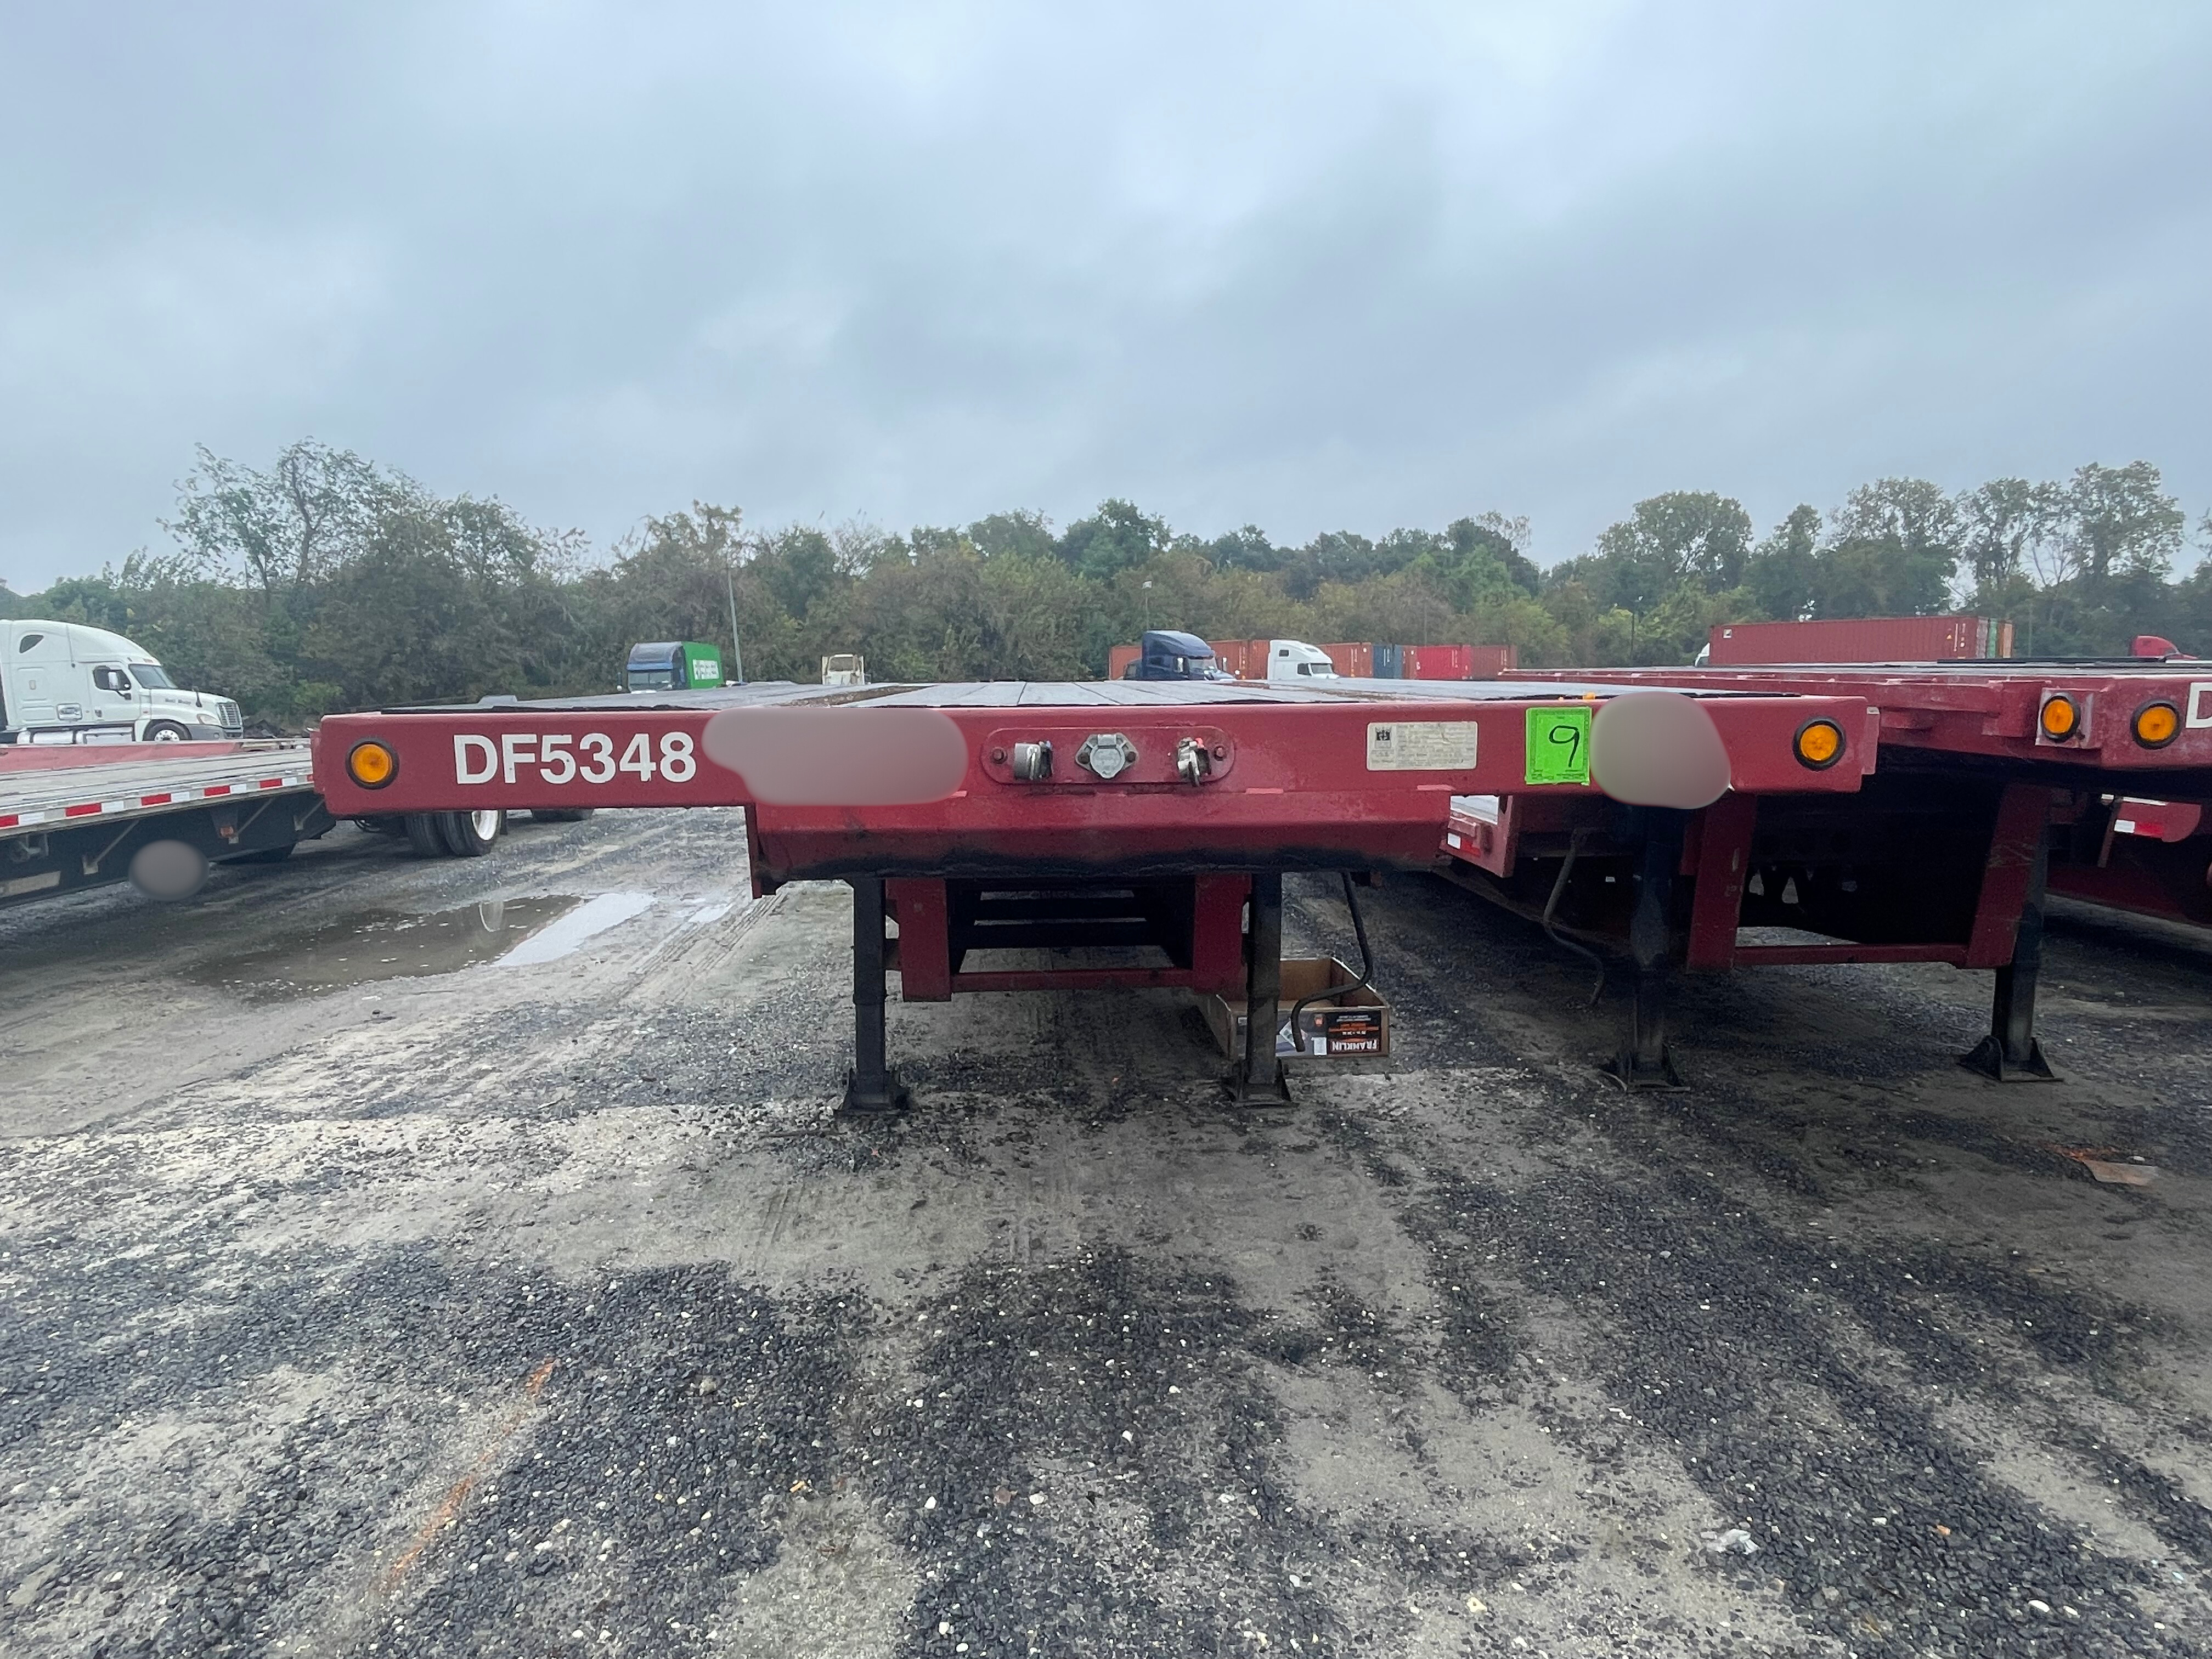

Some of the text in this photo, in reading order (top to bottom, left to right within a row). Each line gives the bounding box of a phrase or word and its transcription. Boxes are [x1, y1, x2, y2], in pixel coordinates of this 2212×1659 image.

[454, 732, 697, 785] DF5348
[1549, 725, 1580, 768] 9
[1332, 1039, 1377, 1051] FRANKLIN
